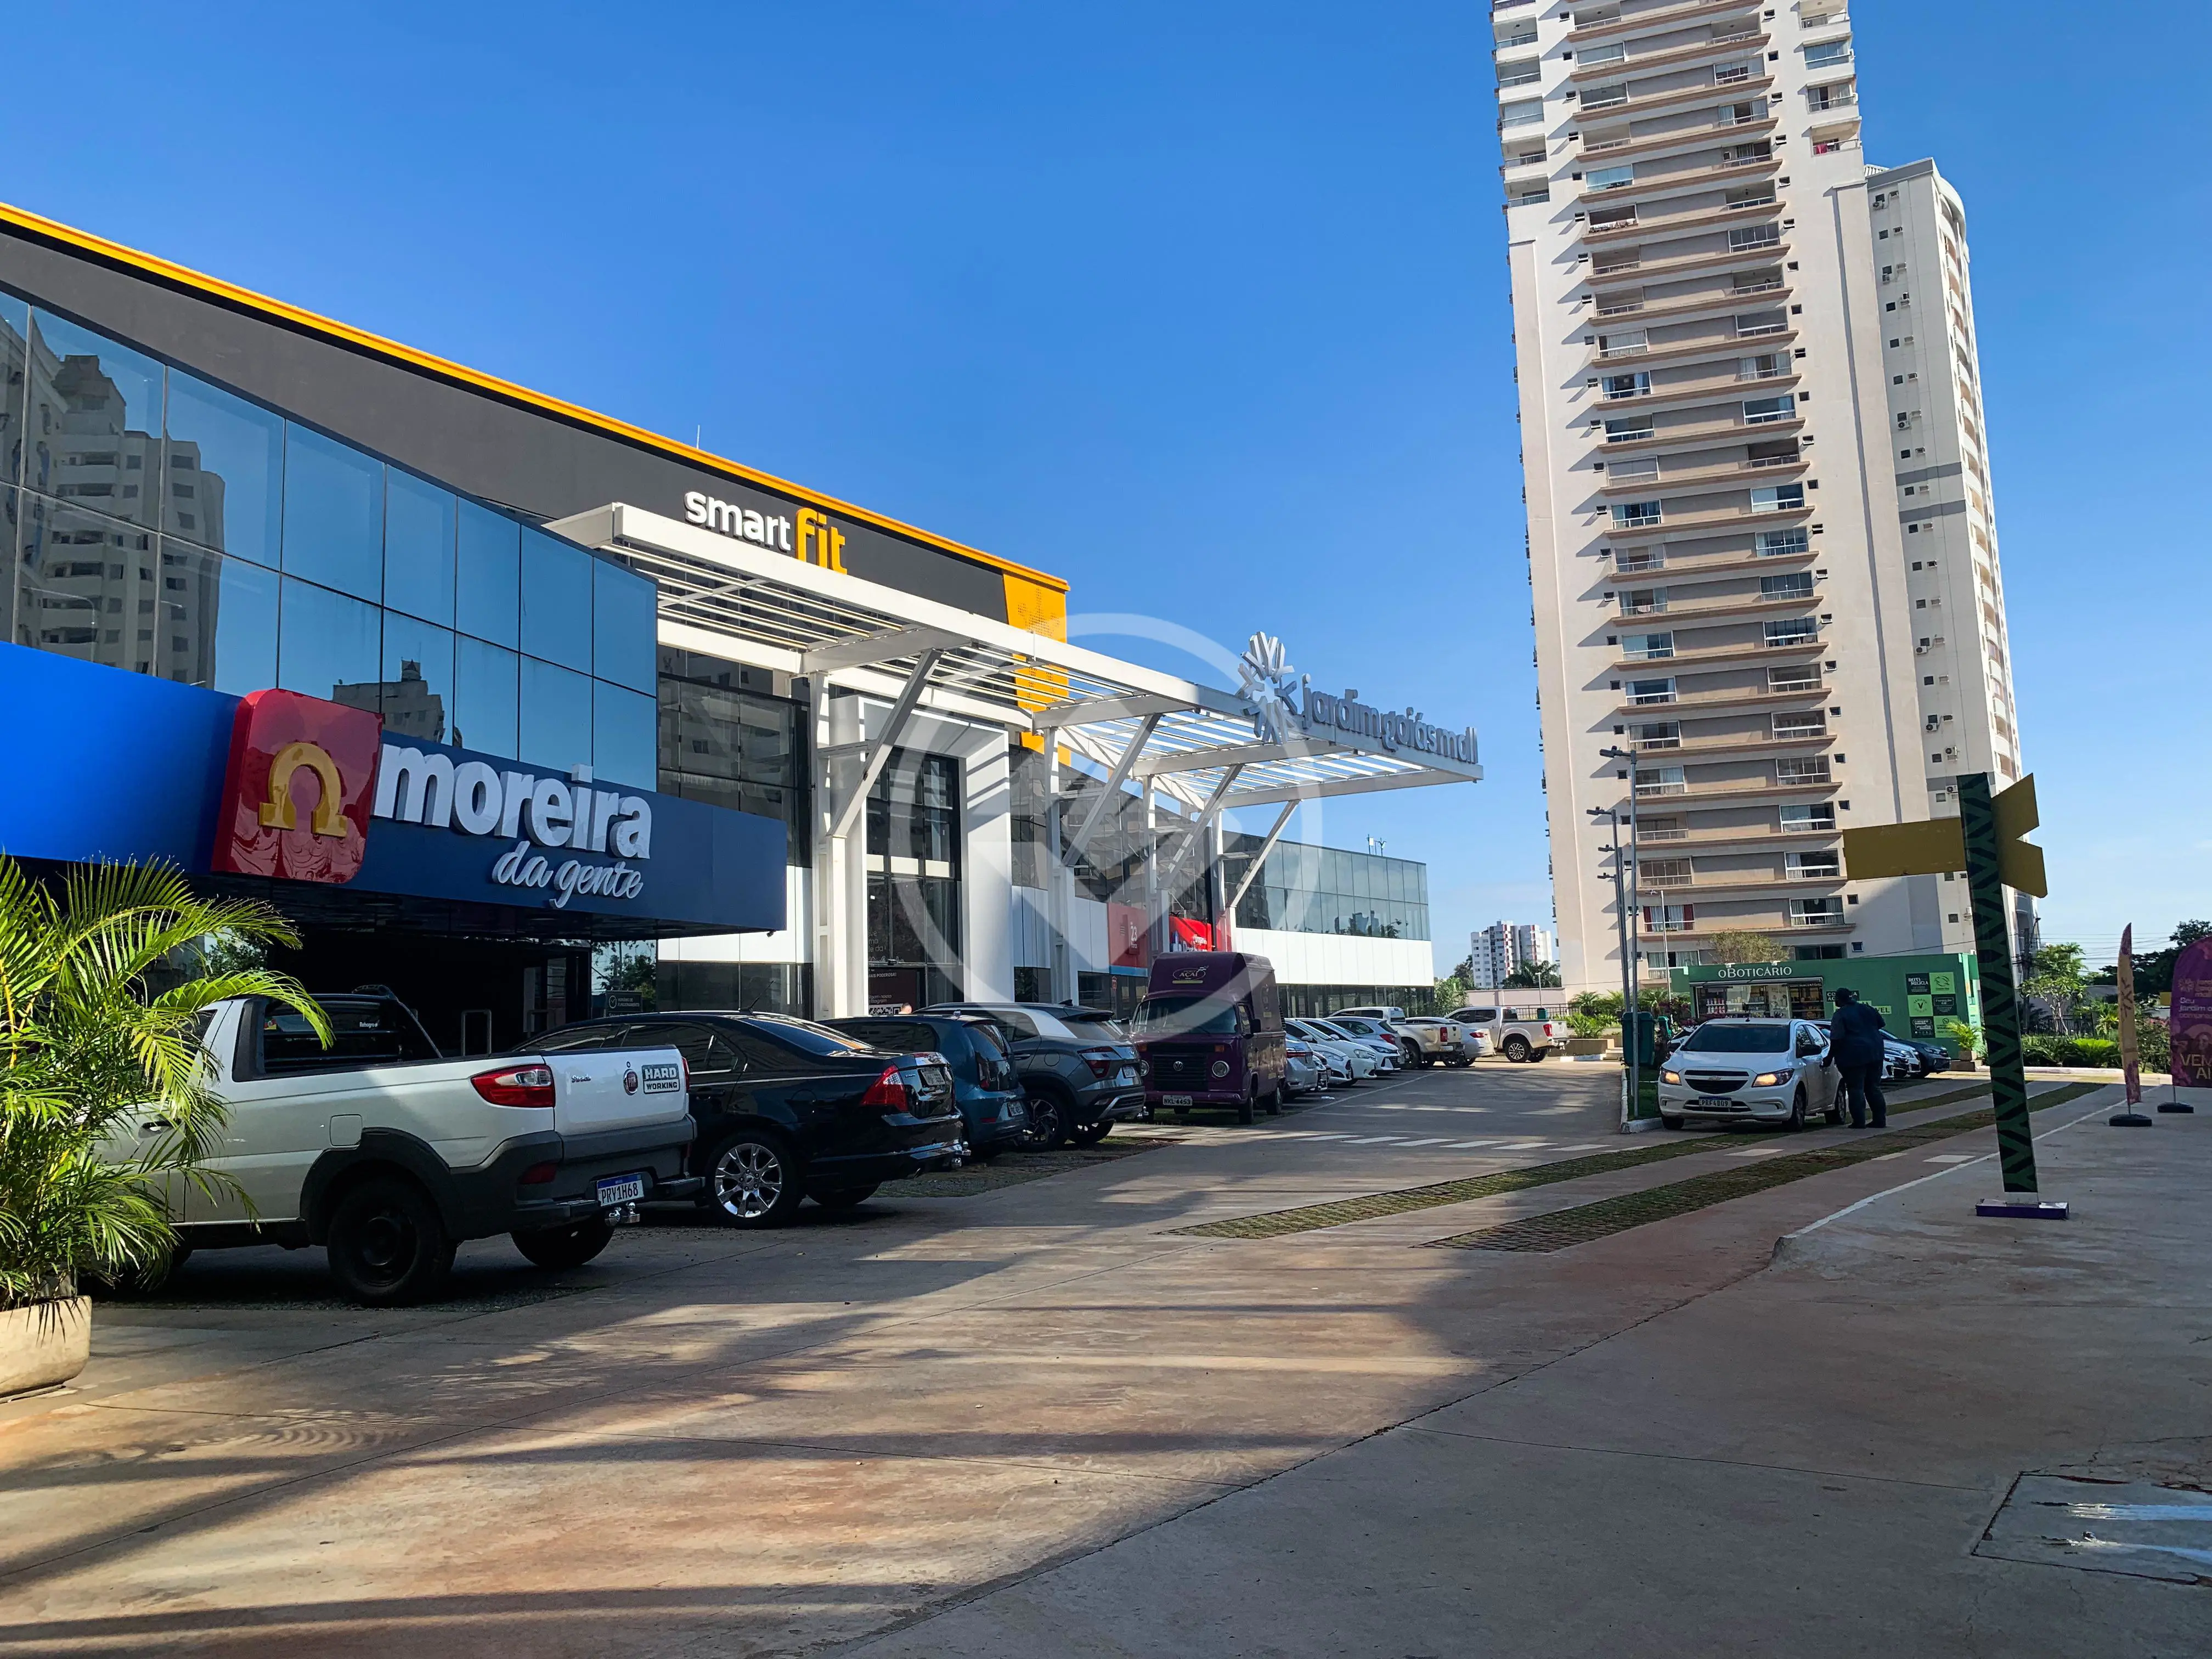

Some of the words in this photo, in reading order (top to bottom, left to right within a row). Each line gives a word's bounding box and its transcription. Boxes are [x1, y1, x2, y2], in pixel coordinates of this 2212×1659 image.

[684, 491, 791, 551] smart
[796, 507, 848, 575] fit
[371, 743, 652, 860] moreira
[492, 841, 554, 888] da
[549, 860, 644, 909] gente
[645, 1068, 677, 1081] HARD
[646, 1081, 678, 1091] WORKING
[601, 1182, 639, 1204] PRY1H68
